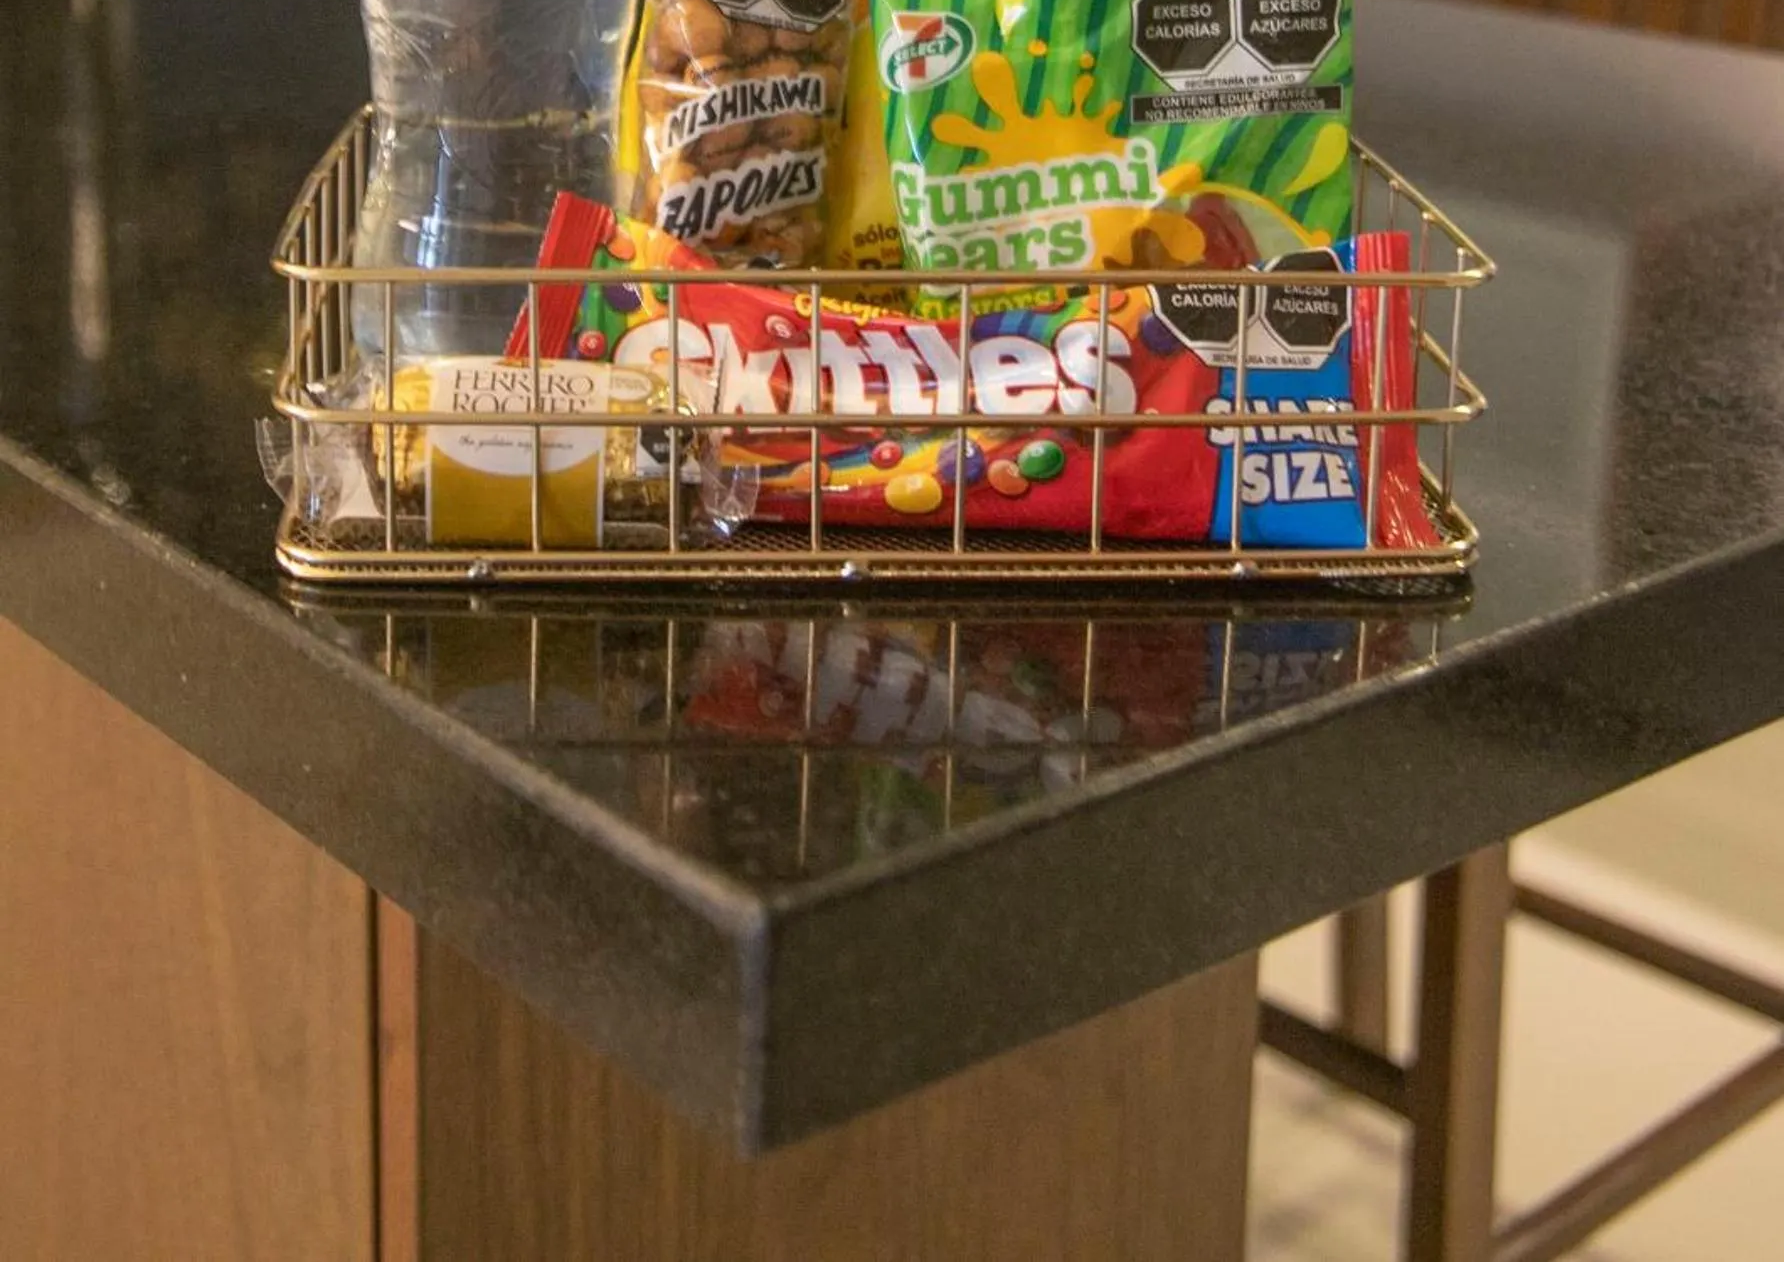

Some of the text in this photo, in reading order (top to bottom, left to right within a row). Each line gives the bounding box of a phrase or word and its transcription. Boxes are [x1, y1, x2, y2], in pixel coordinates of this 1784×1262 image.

[1153, 4, 1212, 20] EXCESO
[1250, 16, 1329, 35] AZÚCARES
[1145, 20, 1222, 39] CALORÍAS
[667, 78, 822, 147] NISHIKAWA
[893, 143, 1158, 226] Gummi
[915, 218, 1088, 271] ears
[1171, 292, 1242, 308] CALORÍA
[1273, 298, 1339, 316] AZÚCARES
[613, 310, 1138, 435] Skittles
[1266, 354, 1279, 365] DE
[1281, 355, 1312, 366] SALUD
[1205, 398, 1359, 446] SHARE
[1240, 451, 1355, 505] SIZE
